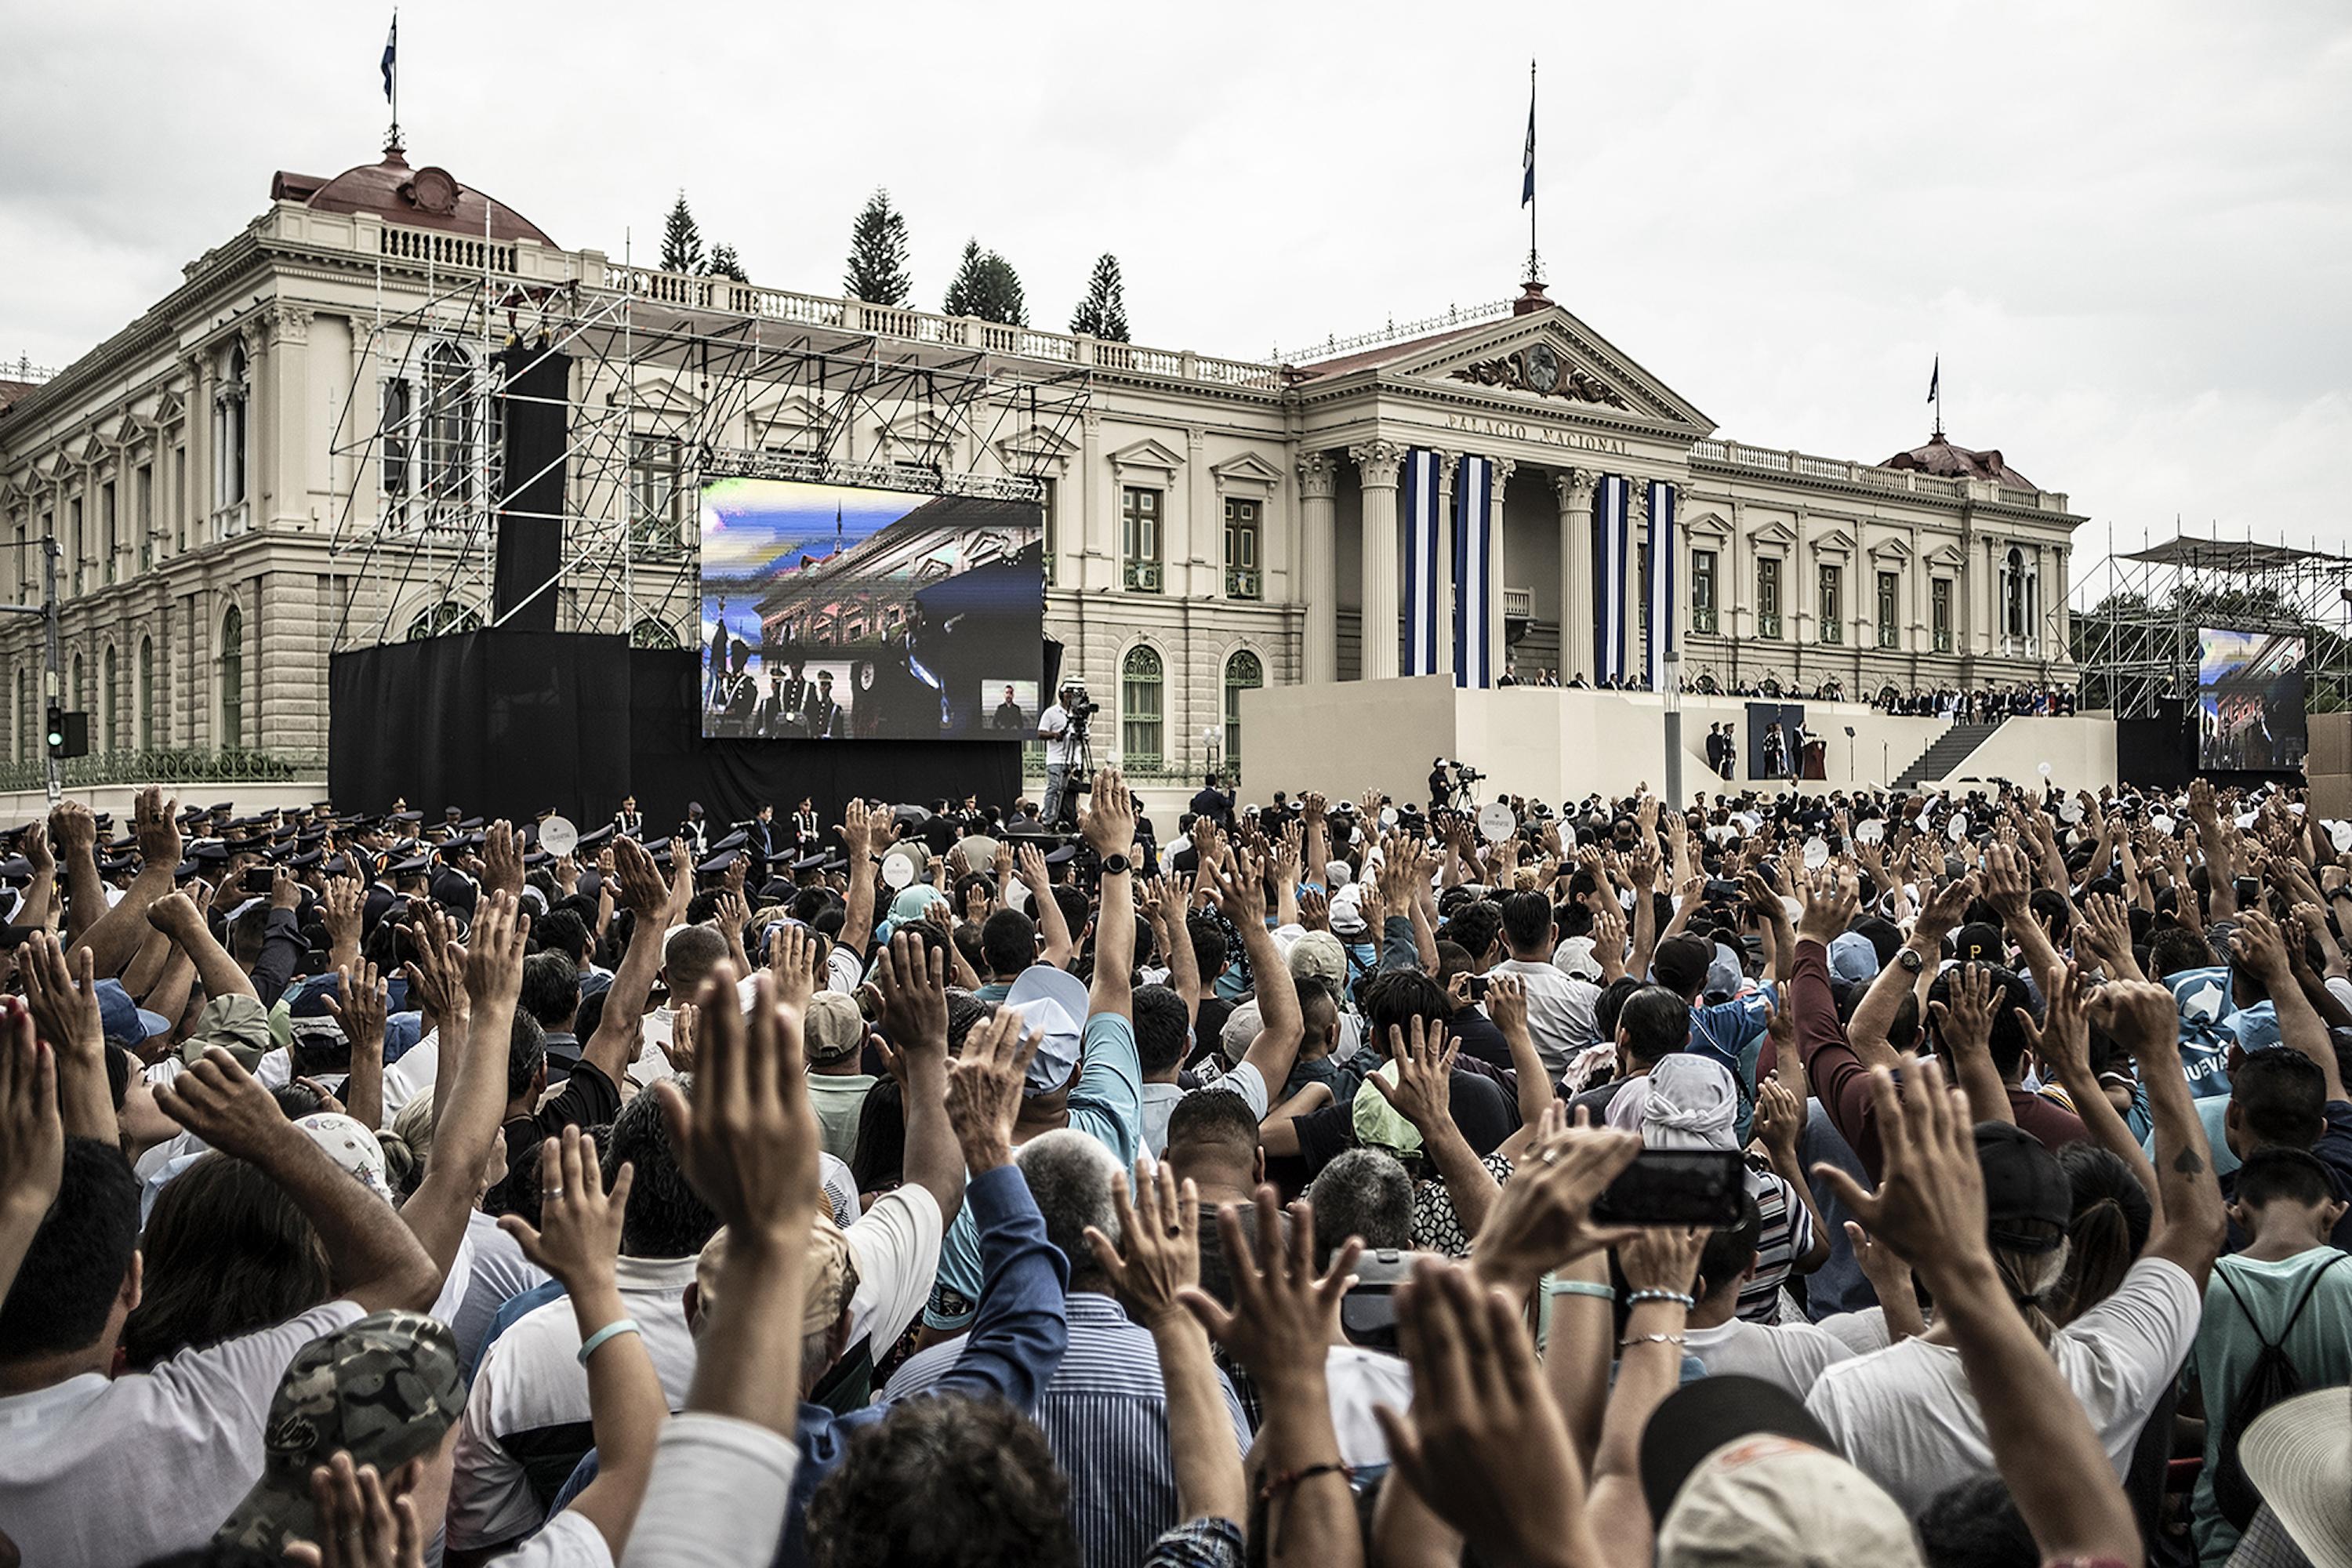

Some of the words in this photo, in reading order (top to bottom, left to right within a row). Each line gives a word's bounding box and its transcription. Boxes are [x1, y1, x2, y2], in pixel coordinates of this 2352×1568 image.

[1446, 413, 1526, 441] PALACIO
[1540, 428, 1632, 456] NACIONAL
[1970, 945, 1981, 960] P
